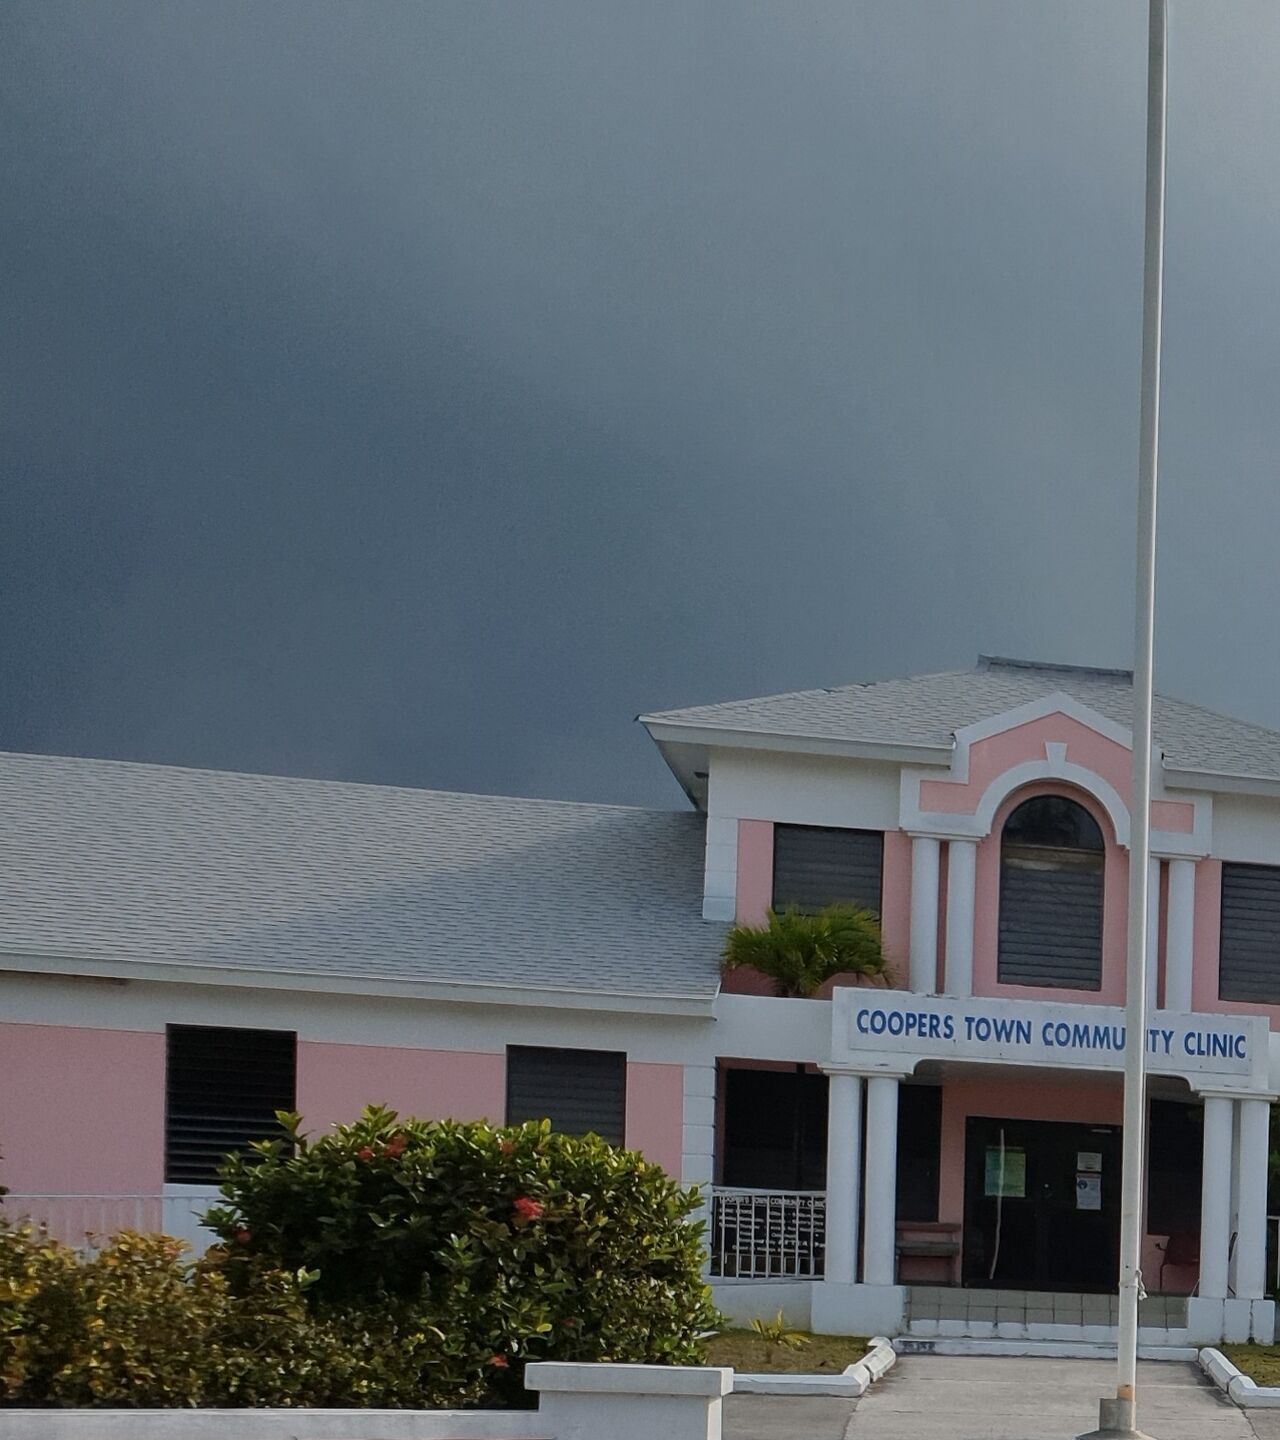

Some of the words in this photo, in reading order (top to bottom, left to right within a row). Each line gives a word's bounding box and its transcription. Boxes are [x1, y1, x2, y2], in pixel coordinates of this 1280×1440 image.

[857, 1009, 954, 1040] COOPERS
[964, 1016, 1032, 1044] TOWN
[1042, 1022, 1175, 1055] COMMUTY
[1184, 1031, 1246, 1059] CLINIC
